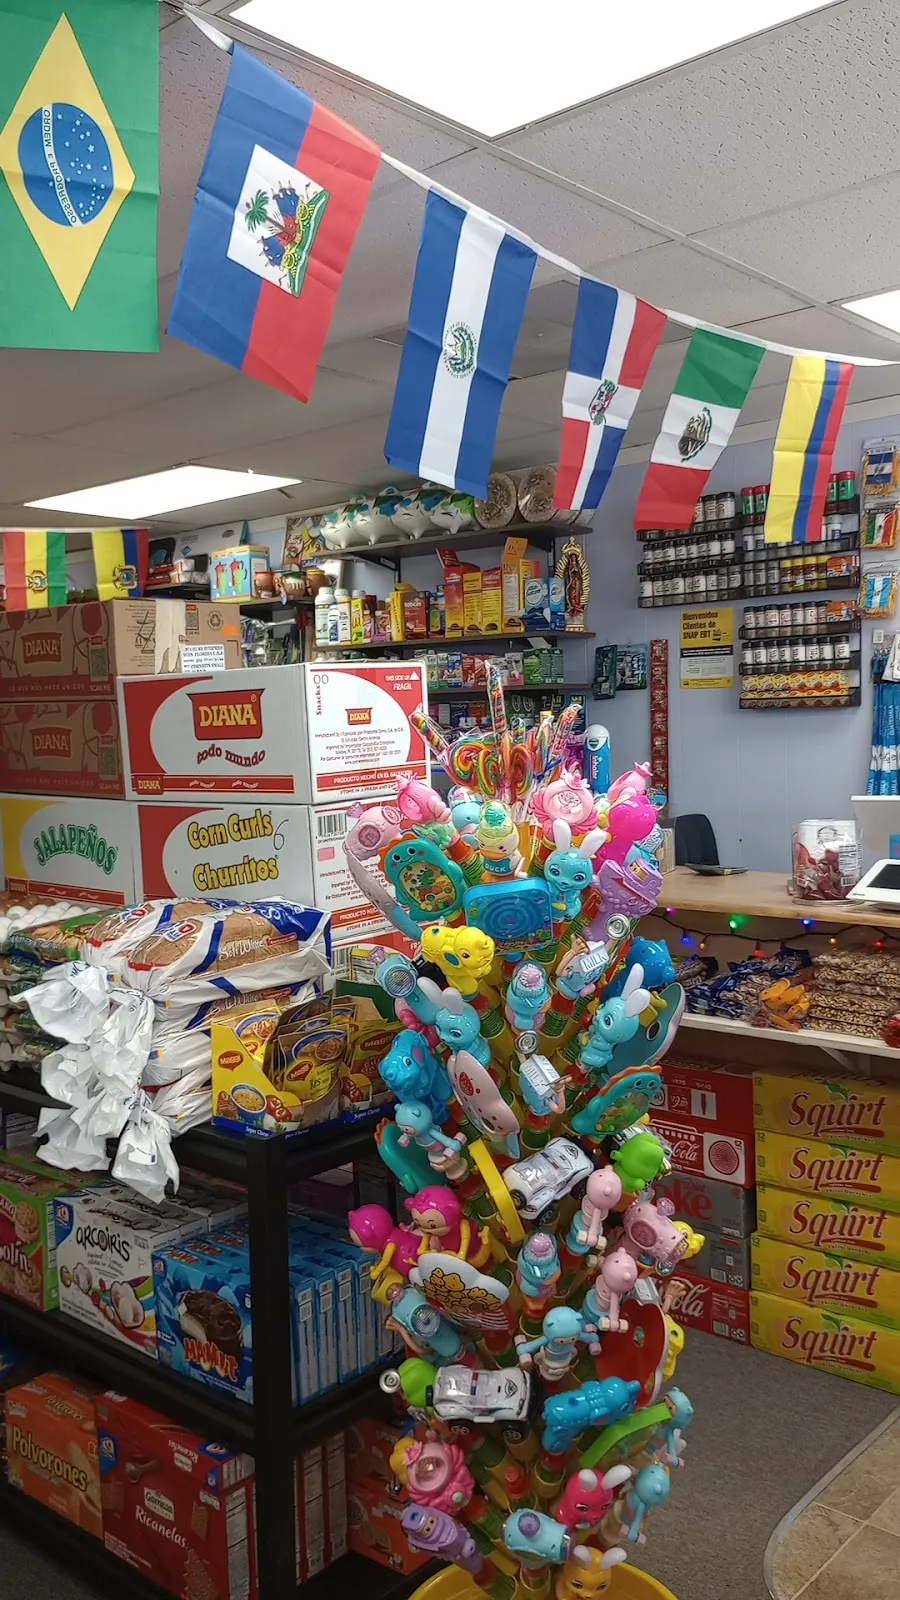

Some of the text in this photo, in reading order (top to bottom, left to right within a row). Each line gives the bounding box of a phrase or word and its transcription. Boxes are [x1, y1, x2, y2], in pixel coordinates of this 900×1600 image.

[682, 611, 718, 621] Bienvenidos
[682, 620, 716, 631] Clientes de
[682, 630, 711, 640] SNAP EBT
[24, 639, 60, 657] DIANA
[199, 703, 257, 727] DIANA
[349, 711, 370, 721] DIANA
[34, 734, 69, 751] DIANA
[225, 750, 266, 768] mundo
[138, 780, 161, 790] DIANA
[333, 775, 360, 784] PRODUCTO
[188, 809, 273, 850] Corn Curls
[33, 824, 118, 875] JALAPEÑOS
[193, 854, 279, 892] Churritos
[484, 863, 506, 872] DUCK
[339, 910, 366, 921] PRODUCTO
[583, 953, 607, 970] MILK
[220, 1055, 241, 1065] Maggi
[290, 1066, 310, 1080] Maggi
[788, 1092, 886, 1137] Squirt
[789, 1147, 884, 1191] Squirt
[789, 1201, 887, 1247] Squirt
[783, 1255, 880, 1301] Squirt
[781, 1316, 877, 1362] Squirt
[12, 1425, 88, 1492] Polvorones
[146, 1491, 173, 1514] Gamesa
